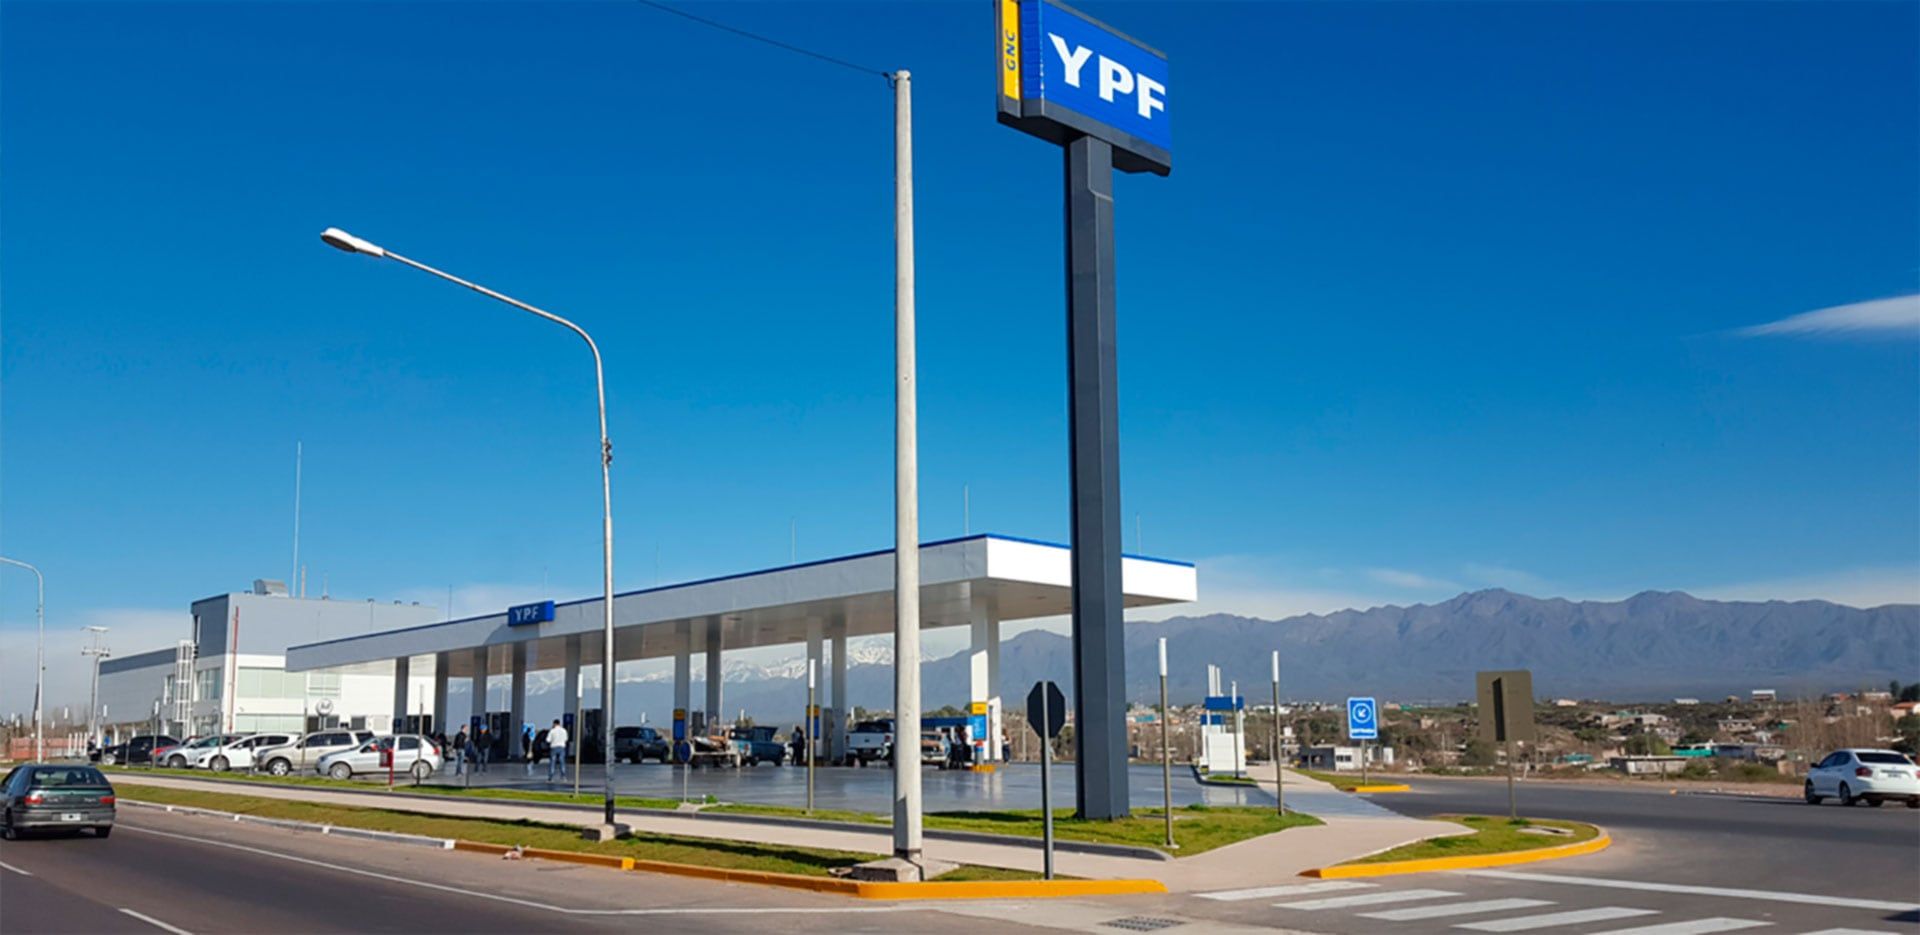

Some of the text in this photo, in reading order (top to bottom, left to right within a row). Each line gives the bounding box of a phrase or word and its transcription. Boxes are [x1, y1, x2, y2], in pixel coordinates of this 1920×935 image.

[1005, 29, 1016, 71] GNC
[1048, 31, 1166, 120] YPF
[514, 605, 539, 621] YPF
